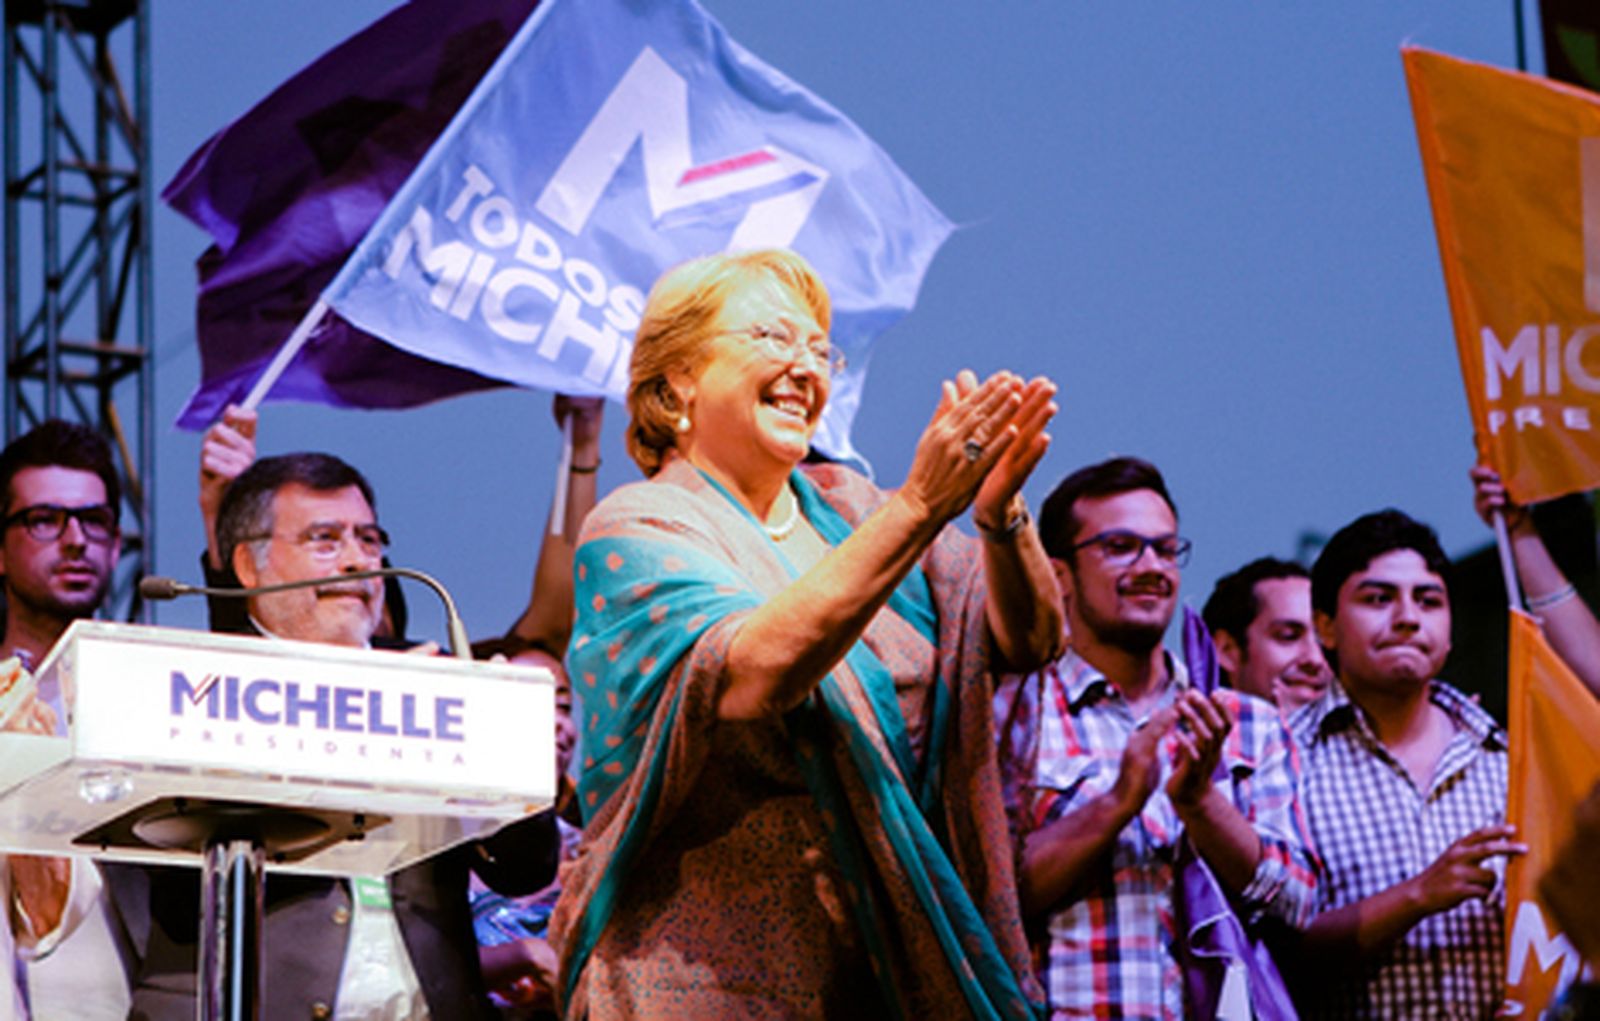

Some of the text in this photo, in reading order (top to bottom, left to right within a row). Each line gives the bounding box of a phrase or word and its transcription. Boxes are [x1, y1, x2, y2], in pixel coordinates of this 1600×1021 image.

[445, 165, 645, 331] TODOS
[1481, 323, 1600, 400] MIC
[1487, 406, 1592, 437] PRE
[170, 670, 466, 742] MICHELLE
[169, 726, 466, 765] PRESIDENTA
[1507, 900, 1593, 1000] M
